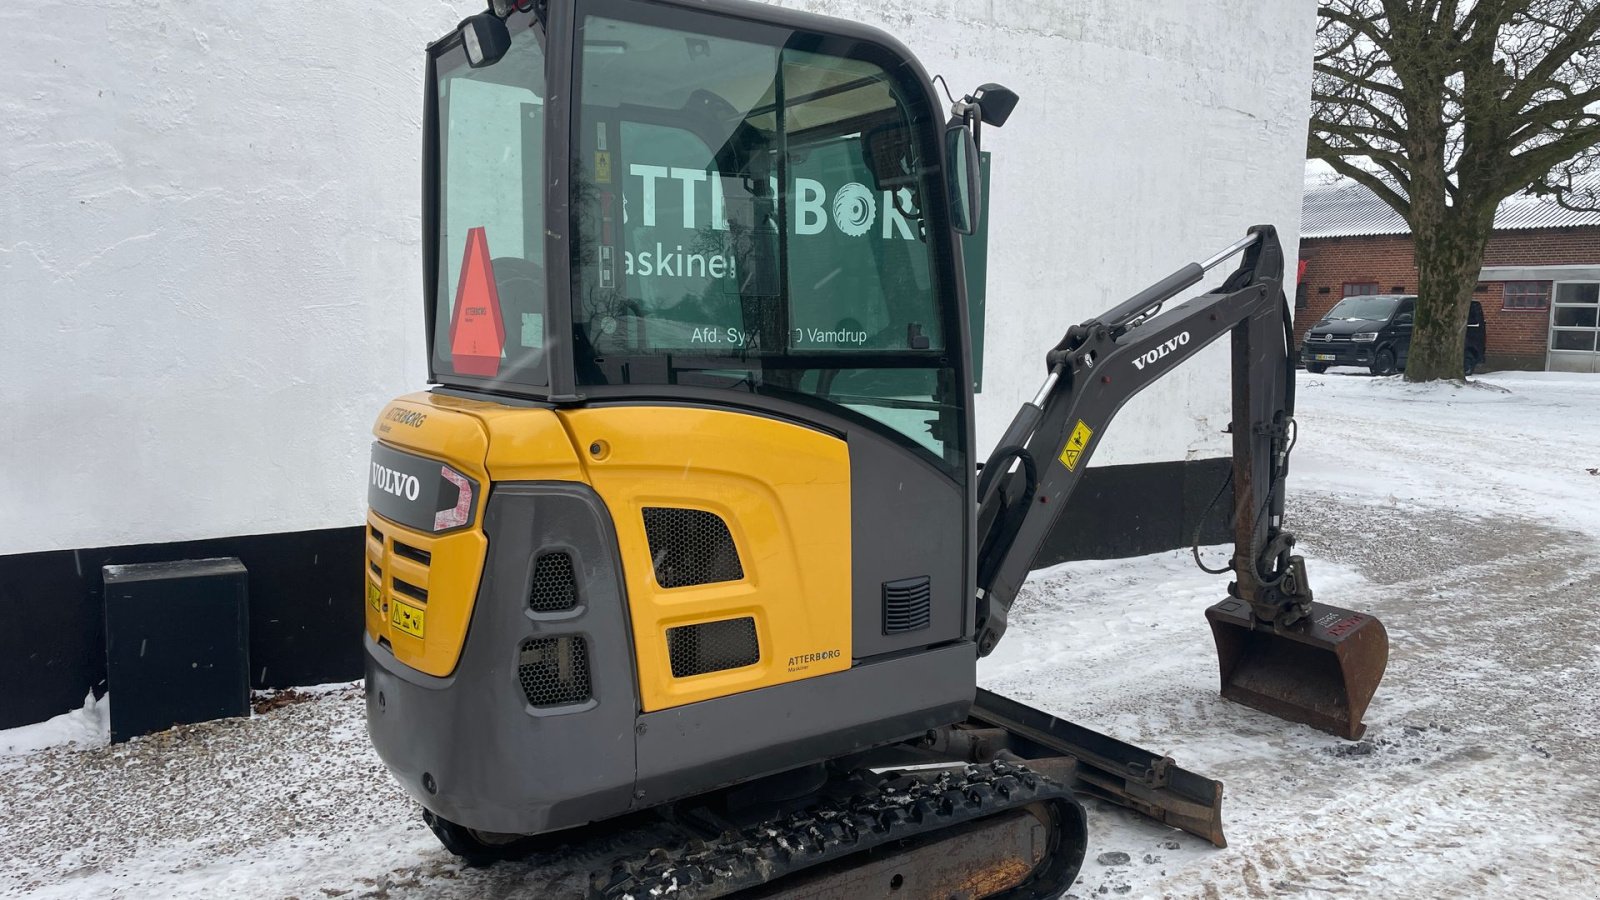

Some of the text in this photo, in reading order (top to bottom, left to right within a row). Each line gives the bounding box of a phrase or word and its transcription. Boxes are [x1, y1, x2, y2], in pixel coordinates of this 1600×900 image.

[691, 327, 721, 344] Afd.
[807, 327, 867, 346] Vamdrup
[1132, 331, 1191, 371] VOLVO
[372, 462, 420, 501] VOLVO
[788, 649, 841, 666] ATTERBORG
